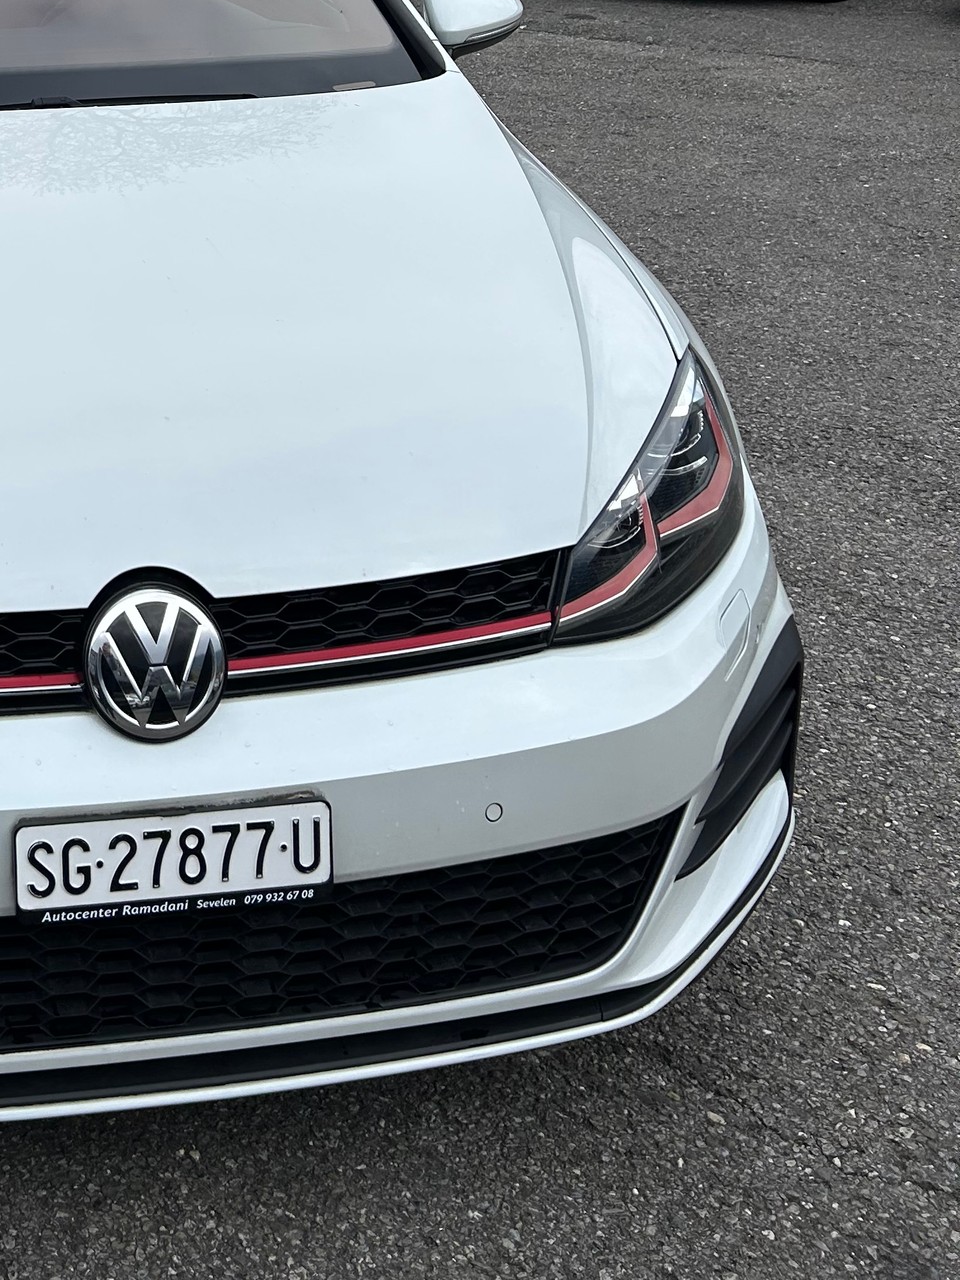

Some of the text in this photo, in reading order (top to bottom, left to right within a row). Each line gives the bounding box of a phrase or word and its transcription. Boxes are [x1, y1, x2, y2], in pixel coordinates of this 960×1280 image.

[41, 888, 314, 923] Autocenter Ramadani Sevelen 079 932 67 08
